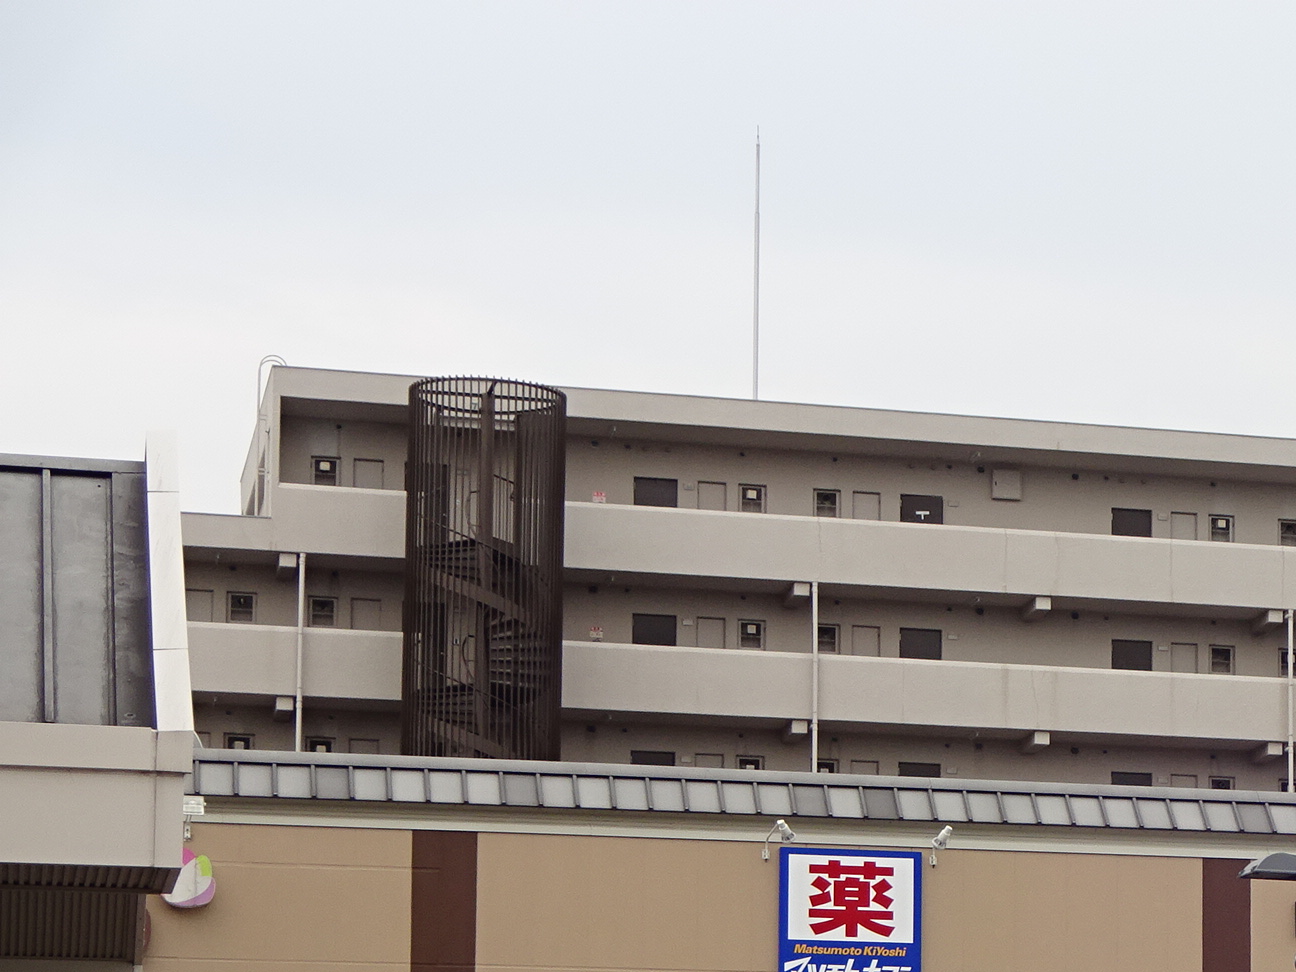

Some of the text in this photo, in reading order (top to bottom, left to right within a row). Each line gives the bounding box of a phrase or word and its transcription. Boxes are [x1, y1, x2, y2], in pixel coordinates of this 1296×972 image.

[808, 860, 896, 938] 薬
[793, 943, 907, 957] Matsumoto KiYoshi
